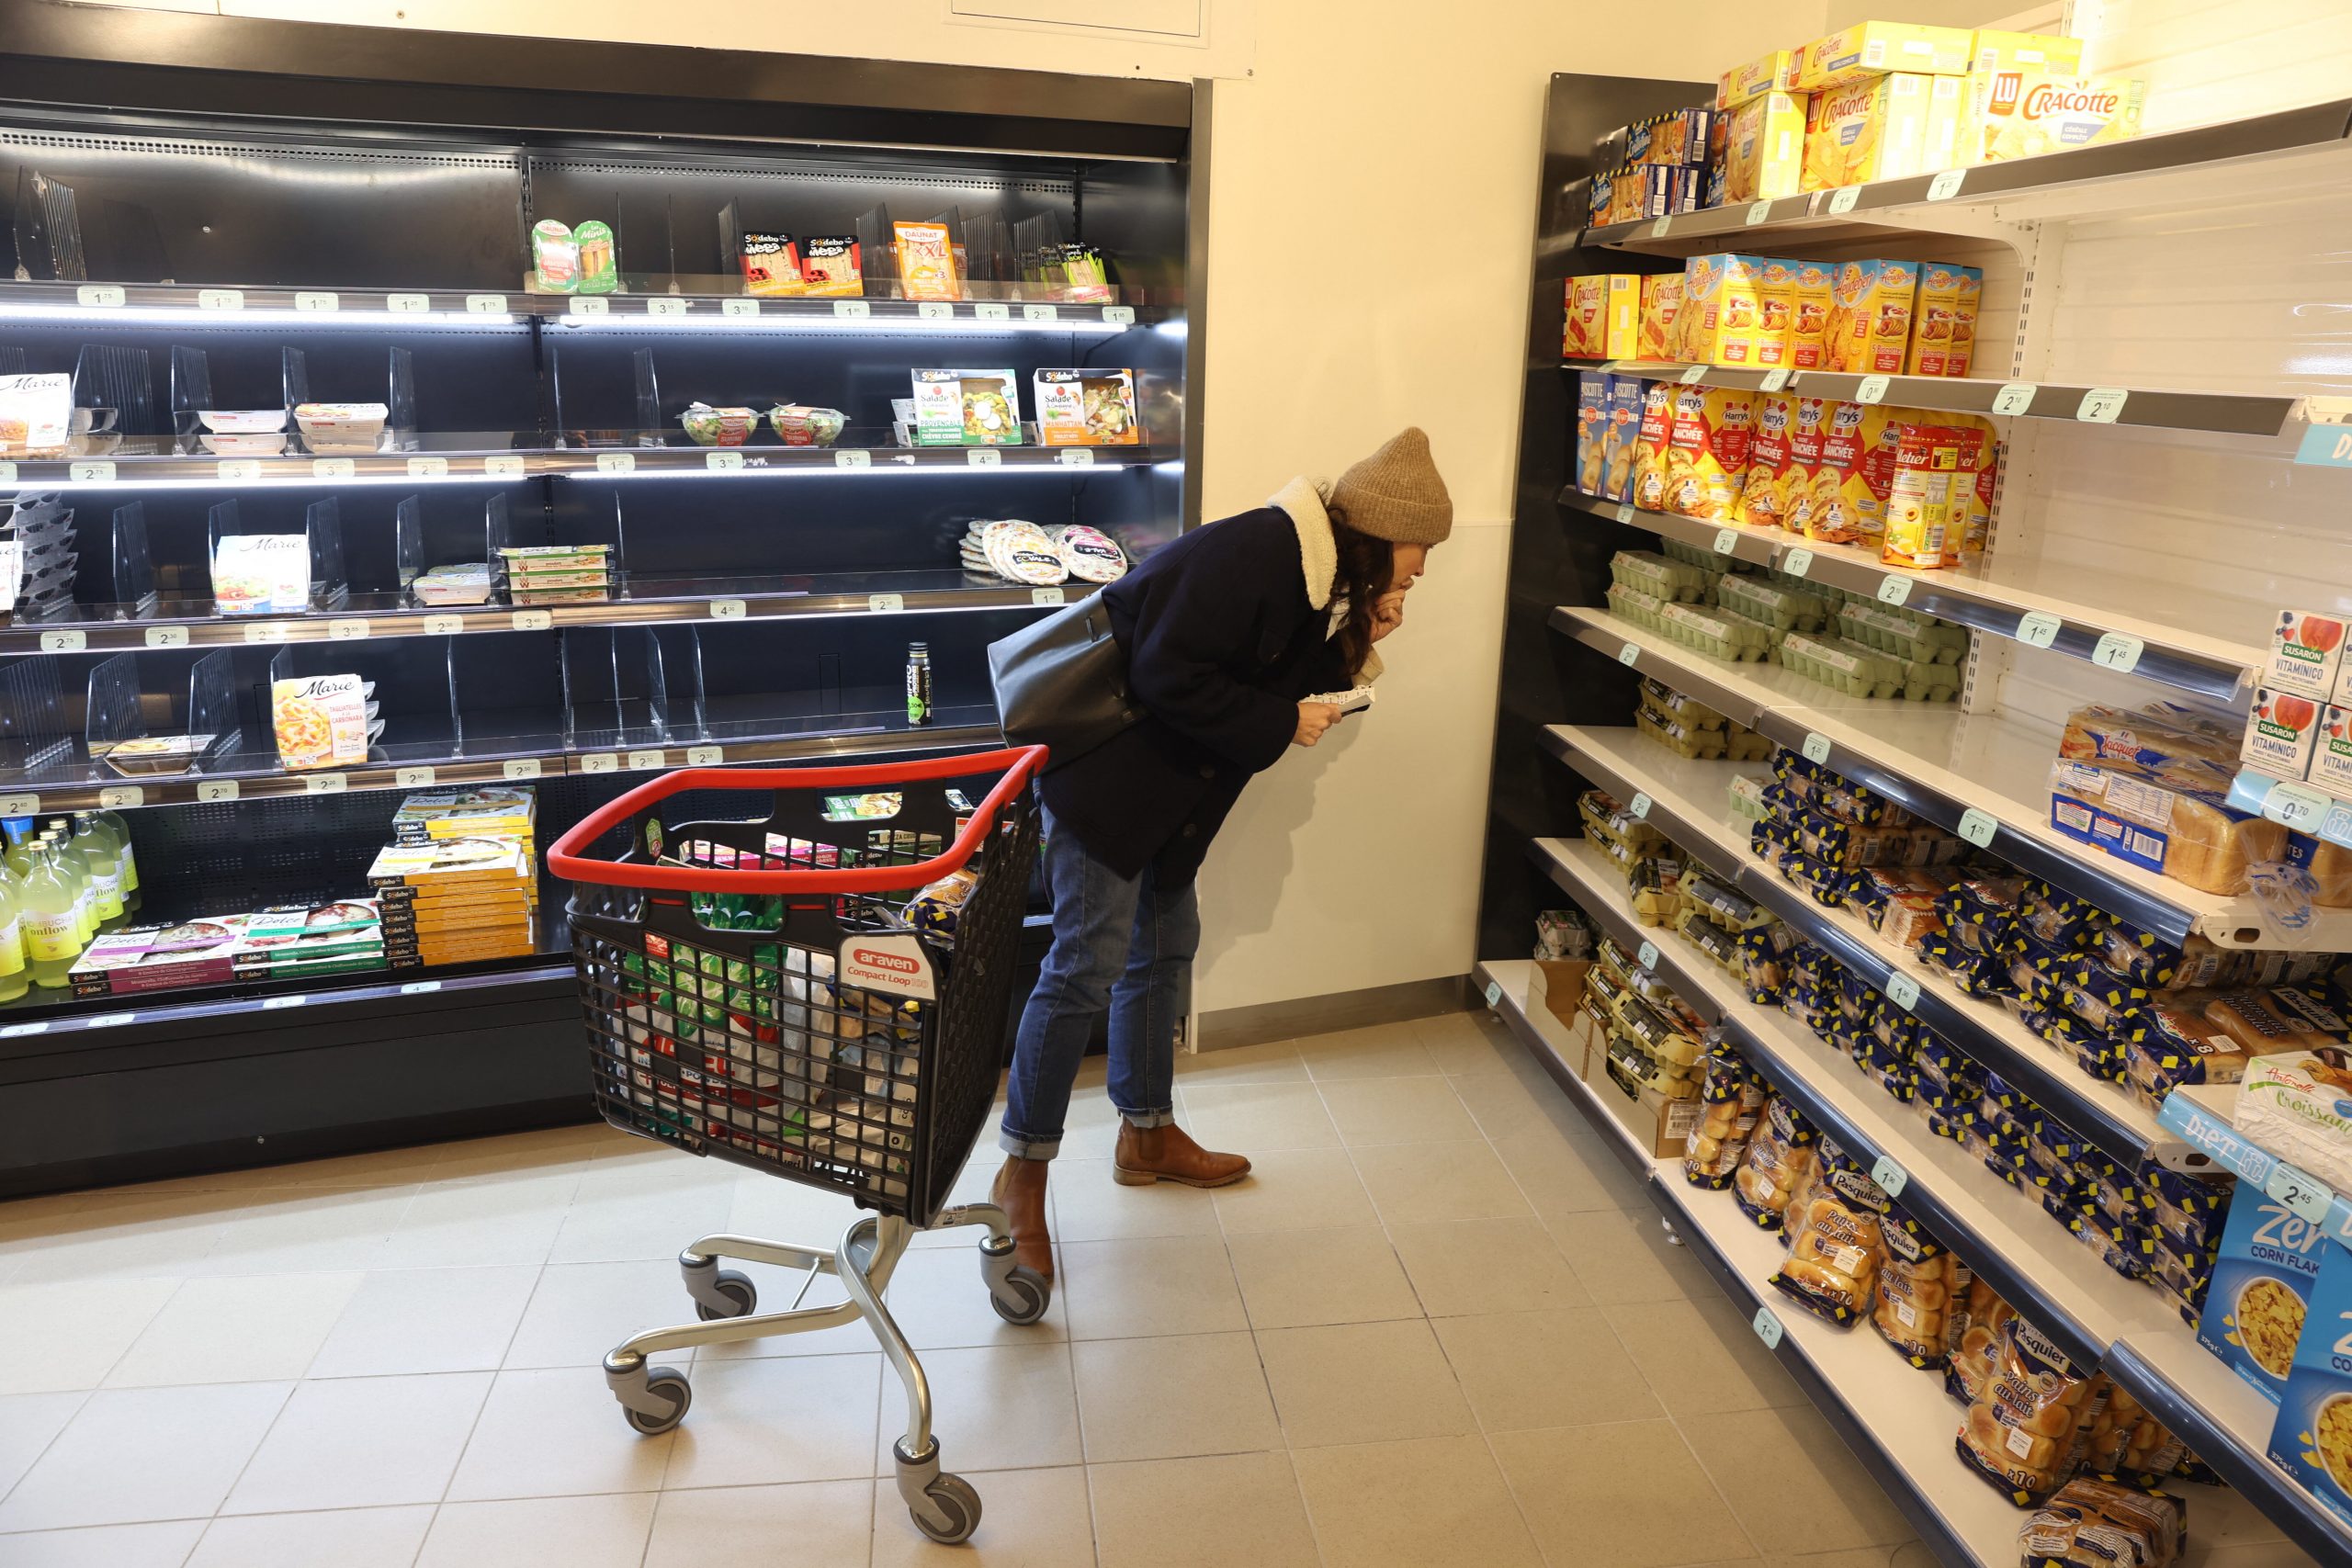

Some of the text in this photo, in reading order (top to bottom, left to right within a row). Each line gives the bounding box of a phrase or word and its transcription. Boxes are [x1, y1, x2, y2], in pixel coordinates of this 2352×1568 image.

[1996, 76, 2018, 102] LU
[905, 230, 938, 239] DAUNAT
[914, 242, 948, 258] XXL
[1834, 270, 1875, 297] Heudebert
[0, 377, 64, 391] Marie
[921, 392, 949, 402] Salade
[1045, 392, 1071, 403] Salade
[241, 536, 302, 552] Marie
[2284, 646, 2322, 661] SUSARON
[2276, 658, 2324, 681] VITAMÍNICO
[294, 680, 355, 698] Marie
[2259, 725, 2295, 740] SUSARON
[2101, 735, 2143, 761] Jacquet
[2252, 735, 2297, 759] VITAMÍNICO
[2332, 742, 2352, 755] SUSA
[96, 887, 117, 897] flow
[860, 952, 913, 971] araven
[847, 965, 910, 987] Compact Loop
[2197, 1040, 2215, 1054] 8
[1837, 1175, 1883, 1206] Pasquier
[1826, 1210, 1860, 1233] Pains
[2251, 1246, 2319, 1275] CORN FLAK
[2018, 1325, 2066, 1366] Pasquier
[2006, 1371, 2039, 1402] Pains
[1995, 1382, 2034, 1418] au lait
[2017, 1470, 2037, 1490] 10
